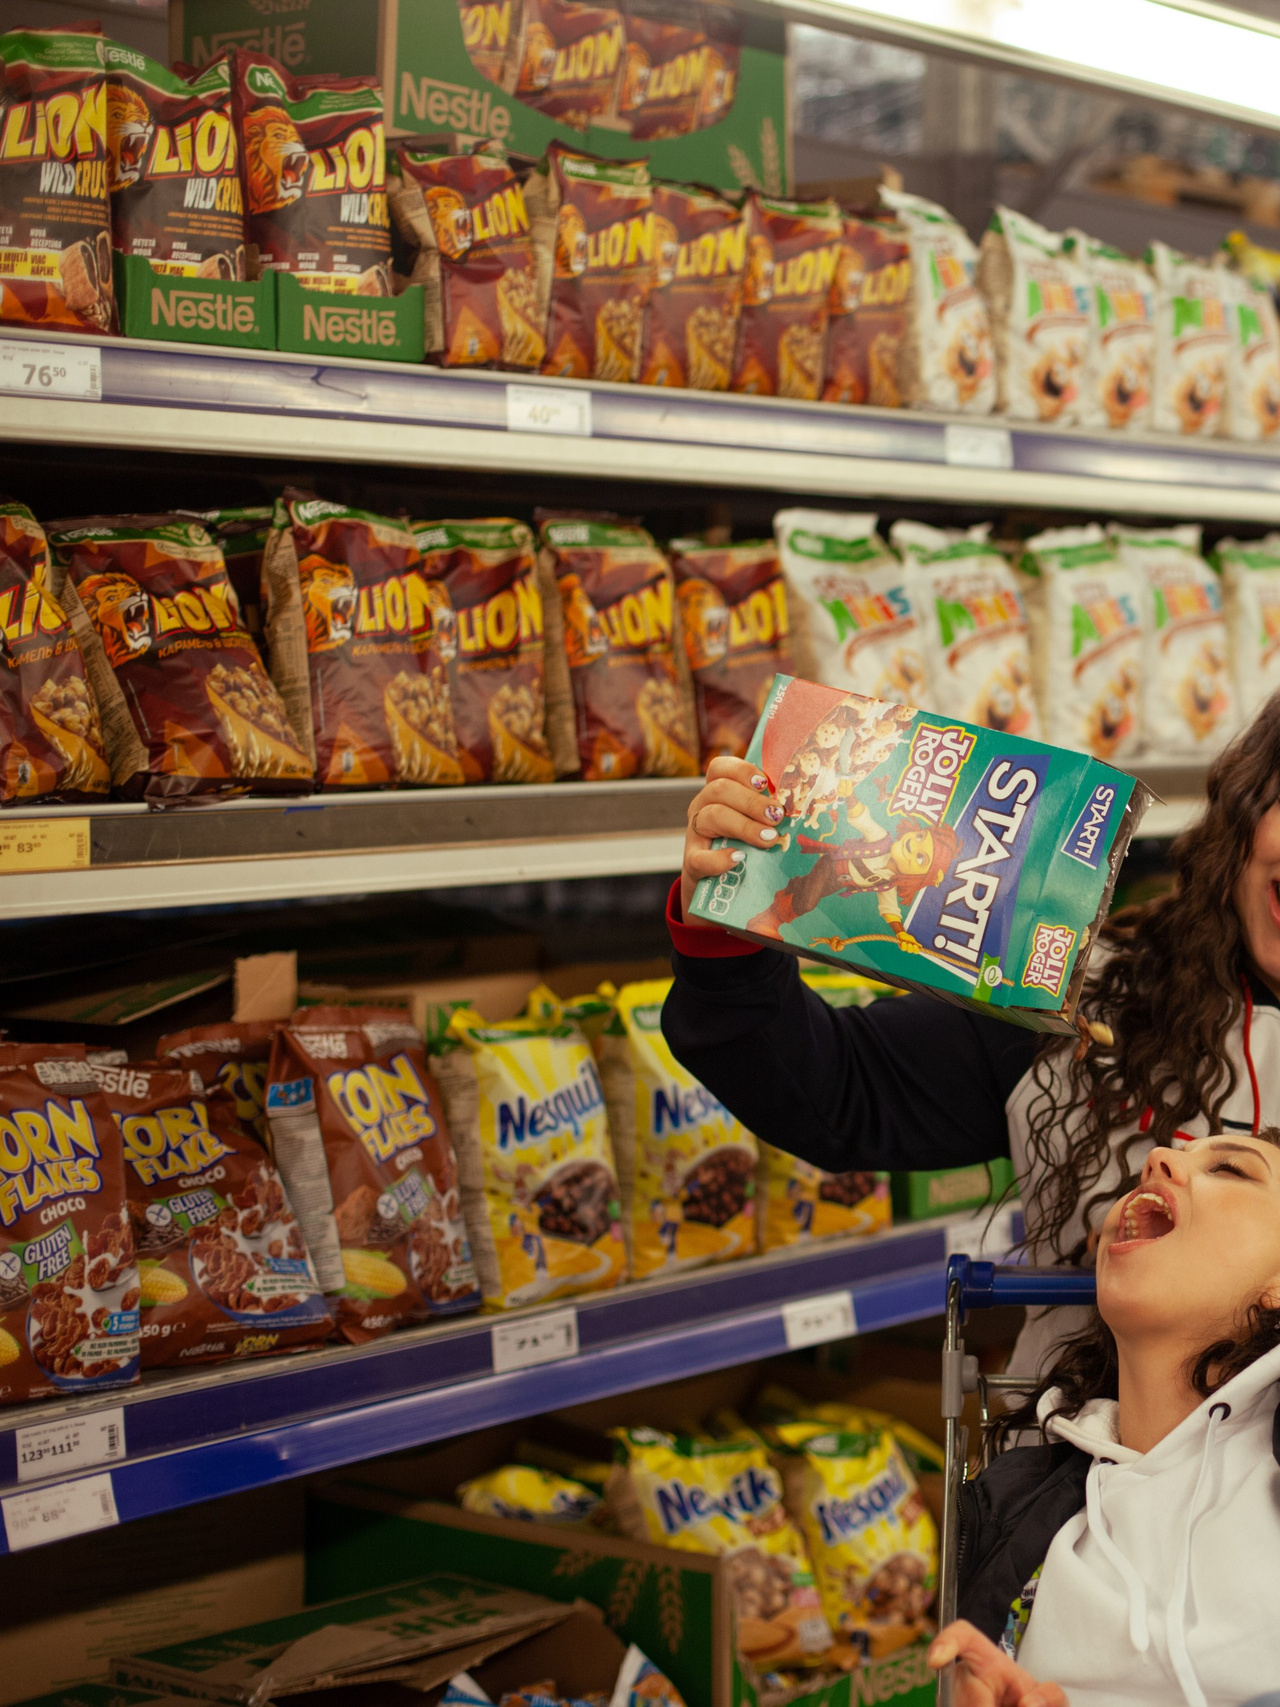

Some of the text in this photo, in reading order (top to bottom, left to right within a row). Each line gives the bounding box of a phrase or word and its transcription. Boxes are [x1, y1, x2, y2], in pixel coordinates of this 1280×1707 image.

[552, 24, 624, 83] LION
[1, 82, 107, 159] LION
[472, 181, 531, 242] LION
[587, 211, 656, 269] LION
[673, 222, 748, 278] LION
[774, 243, 843, 296] LION
[151, 287, 255, 333] Nestlé
[303, 304, 397, 347] Nestlé
[458, 576, 543, 652] LION
[774, 683, 787, 704] 250
[893, 729, 941, 812] ROGER
[916, 730, 971, 823] JOLLY
[1074, 785, 1115, 859] START!
[934, 760, 1039, 964] START!
[1025, 927, 1053, 985] ROGER
[1038, 928, 1076, 992] JOLLY
[0, 1100, 100, 1174] ORN
[131, 1131, 236, 1186] FLAKE
[0, 1157, 101, 1227] FLAKES
[178, 1165, 226, 1189] CHOCO
[40, 1197, 87, 1225] CHOCO
[187, 1201, 220, 1226] FREE
[24, 1223, 73, 1265] GLUTEN
[38, 1246, 72, 1282] FREE
